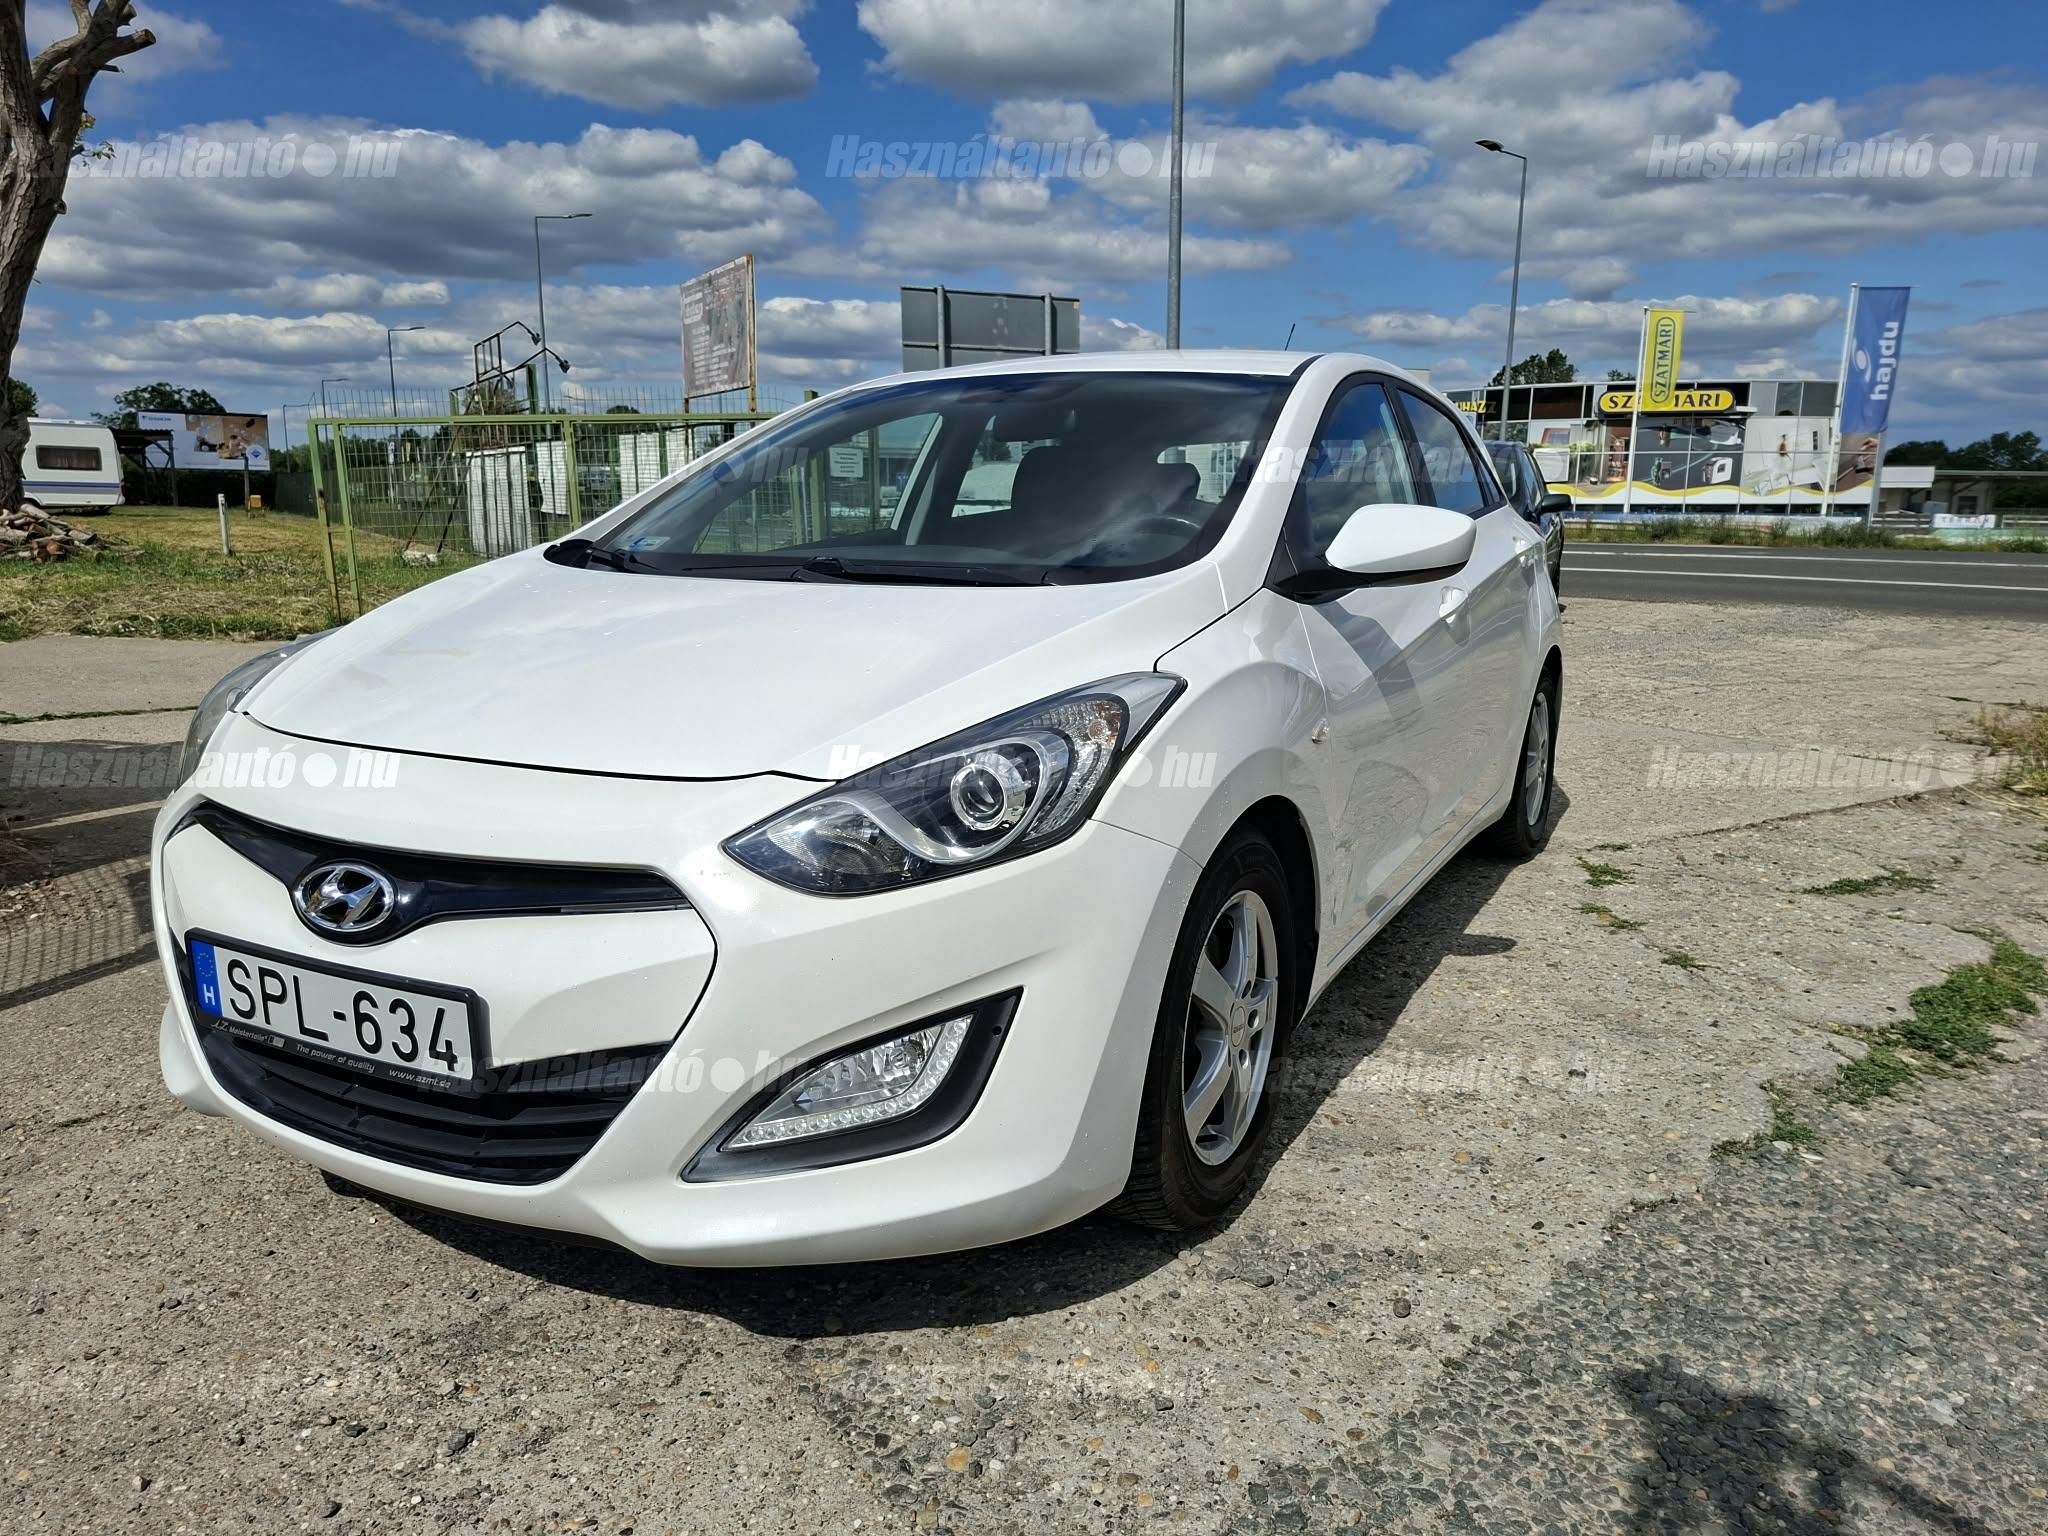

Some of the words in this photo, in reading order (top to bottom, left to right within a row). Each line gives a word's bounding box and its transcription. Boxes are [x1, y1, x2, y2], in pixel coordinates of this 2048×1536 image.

[1654, 323, 1673, 397] SZATMÁRI
[1870, 322, 1899, 400] hajdu
[1608, 389, 1720, 409] SZÁRI
[203, 983, 216, 1006] H
[227, 958, 459, 1072] SPL-634
[296, 1043, 310, 1054] The
[311, 1049, 337, 1063] power
[338, 1055, 347, 1063] of
[348, 1059, 376, 1074] quality
